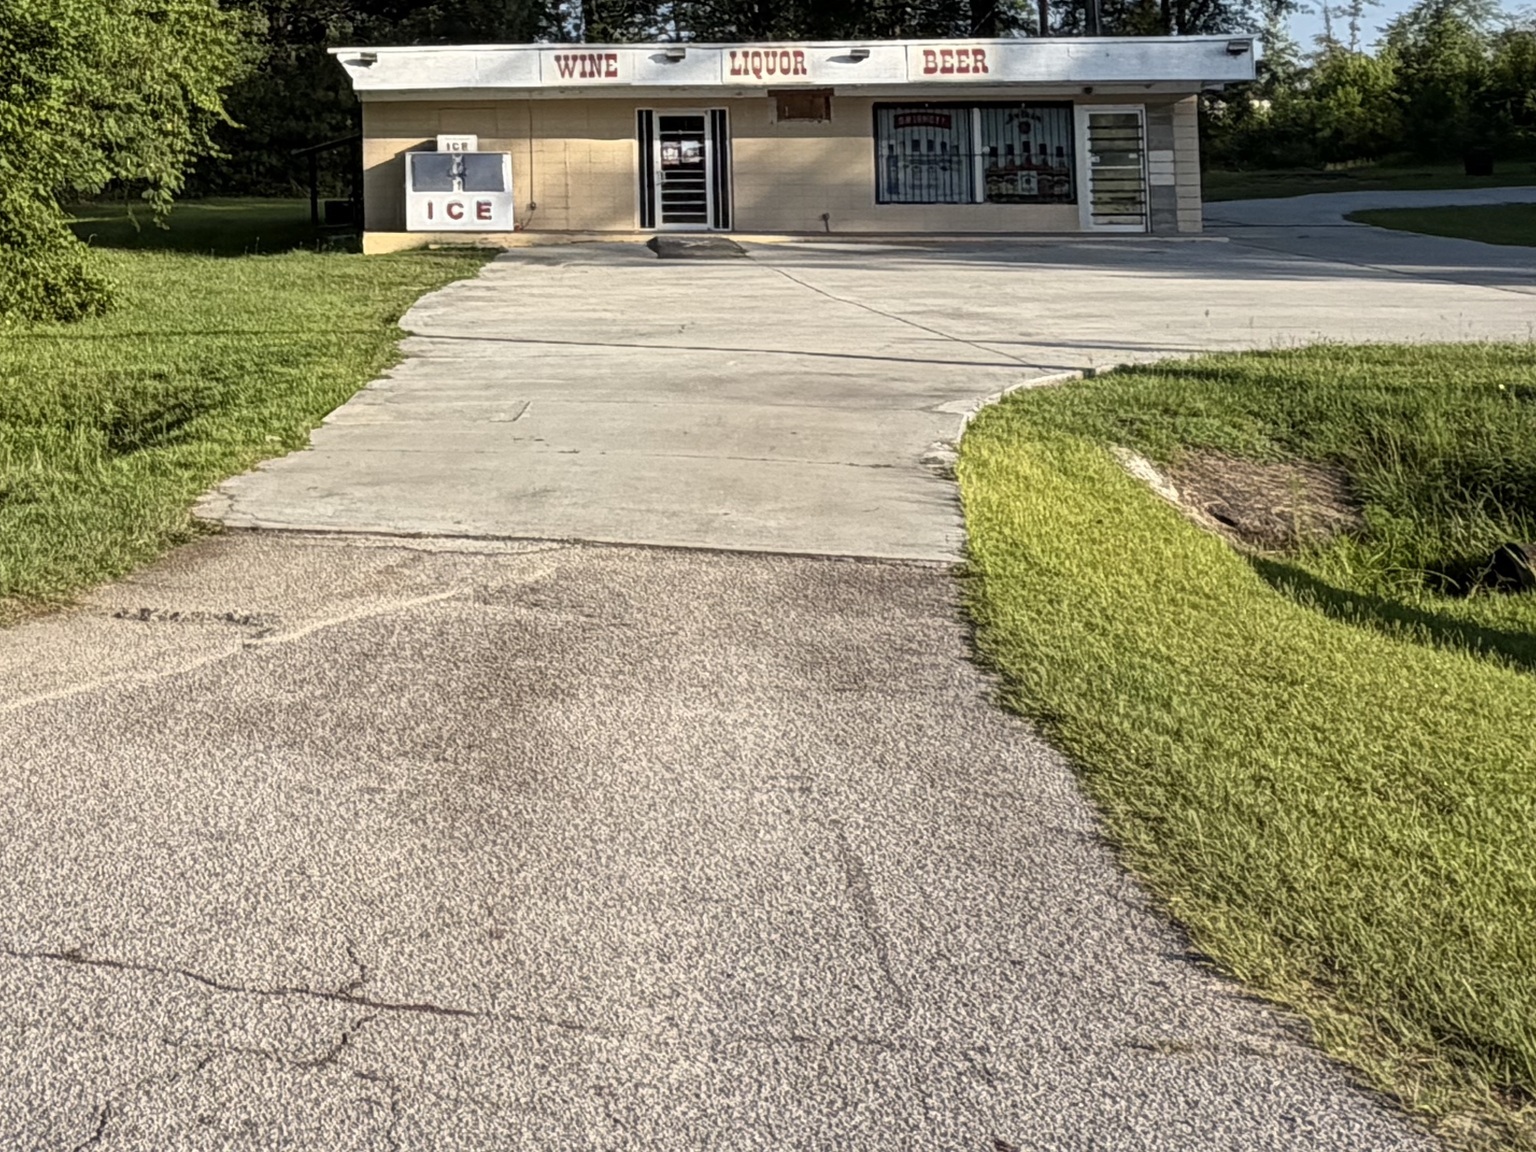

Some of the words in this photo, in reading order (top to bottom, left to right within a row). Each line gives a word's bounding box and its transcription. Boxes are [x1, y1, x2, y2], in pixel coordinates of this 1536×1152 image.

[554, 53, 618, 79] WINE
[729, 50, 807, 79] LIQUOR
[922, 48, 989, 74] BEER
[427, 200, 492, 220] ICE
